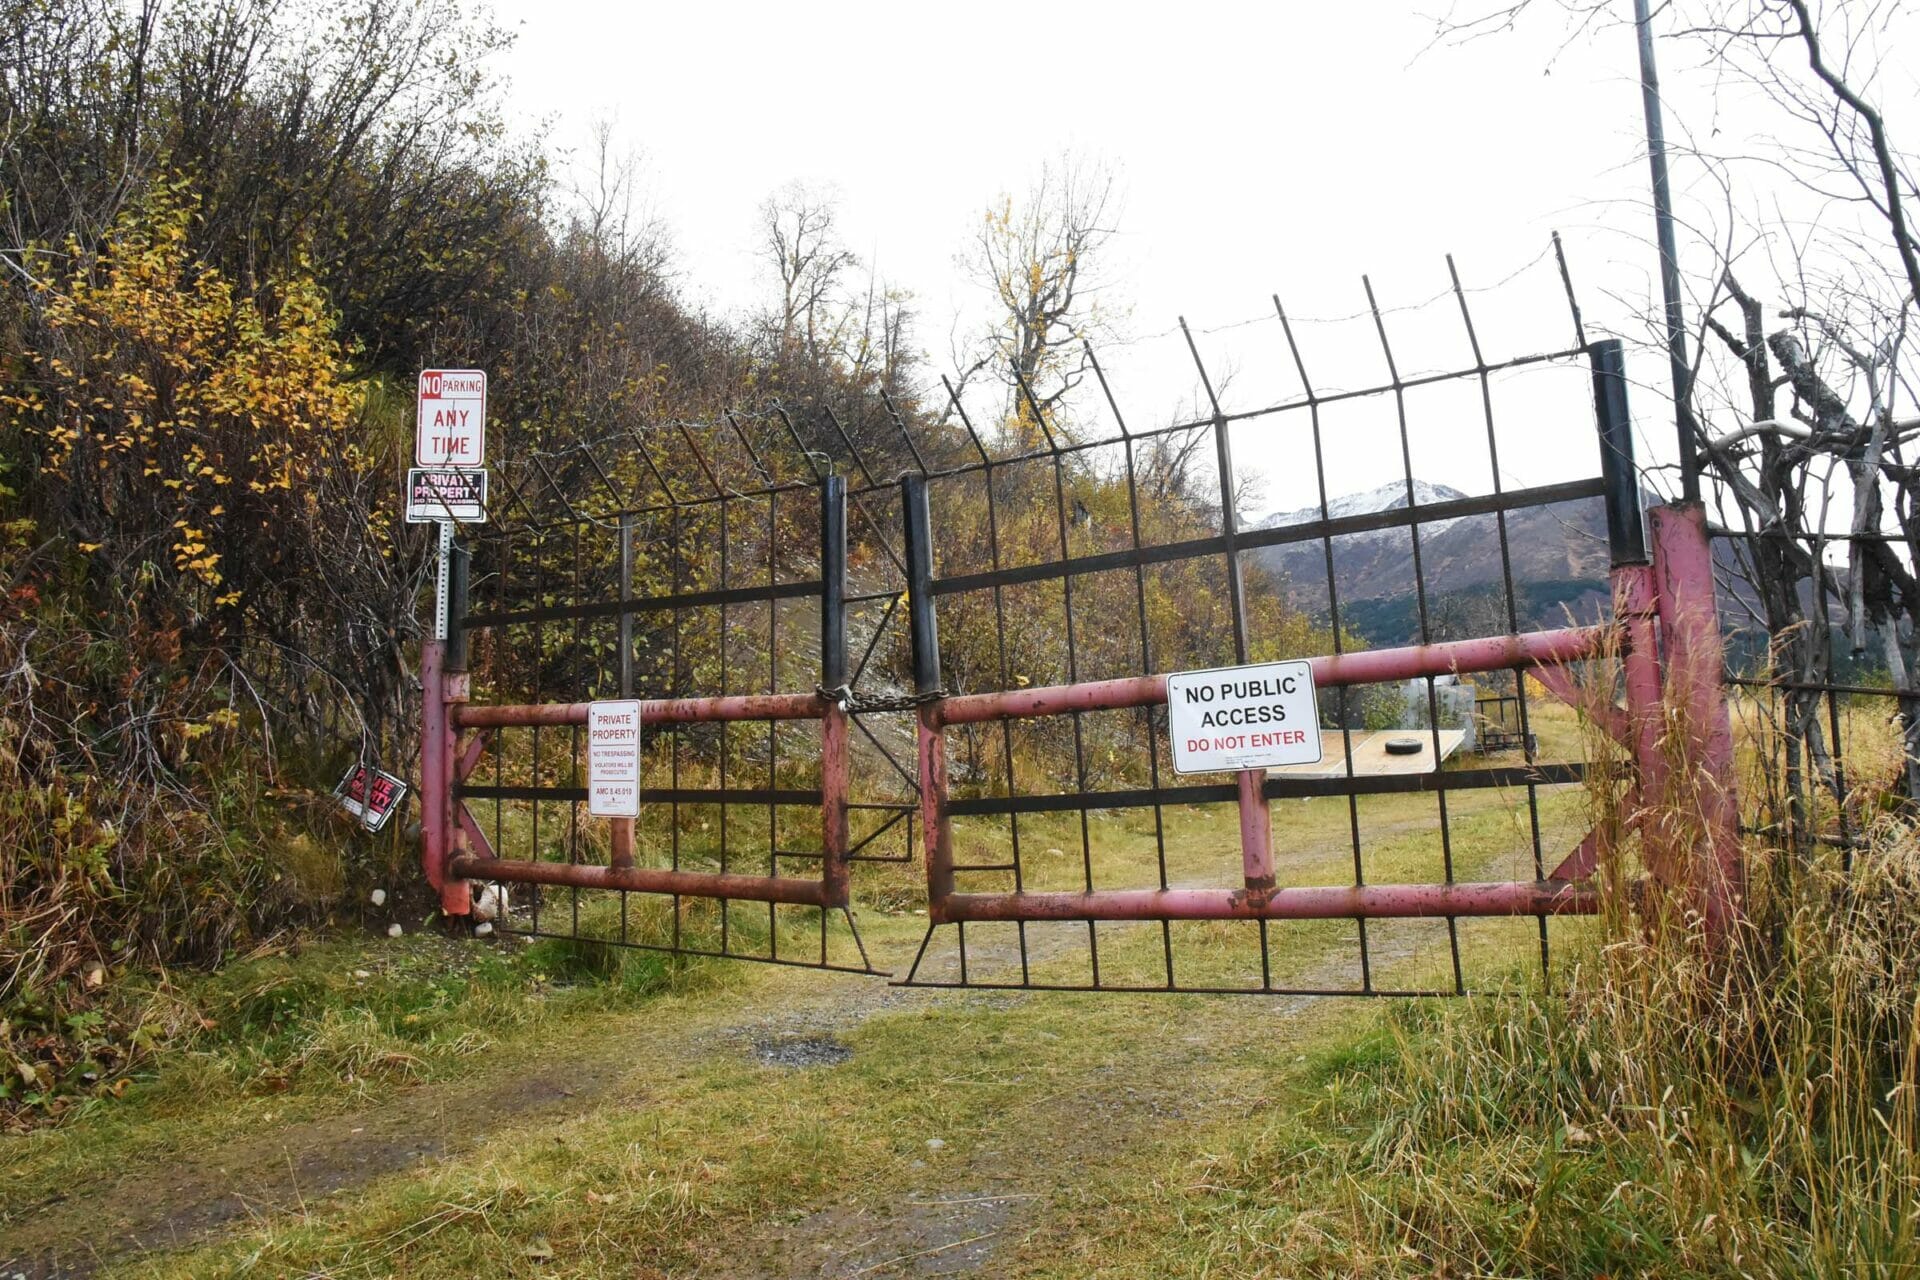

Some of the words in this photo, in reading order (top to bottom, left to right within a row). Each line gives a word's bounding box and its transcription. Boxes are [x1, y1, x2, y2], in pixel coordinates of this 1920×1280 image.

[422, 376, 440, 394] NO
[442, 380, 481, 392] PARKING
[433, 409, 469, 427] ANY
[431, 436, 470, 454] TIME
[1185, 685, 1214, 704] NO
[1221, 677, 1297, 700] PUBLIC
[597, 714, 632, 725] PRIVATE
[1201, 704, 1286, 728] ACCESS
[592, 729, 637, 740] PROPERTY
[1187, 738, 1210, 753] DO
[1214, 735, 1246, 751] NOT
[1251, 730, 1306, 747] ENTER
[596, 787, 609, 795] AMC
